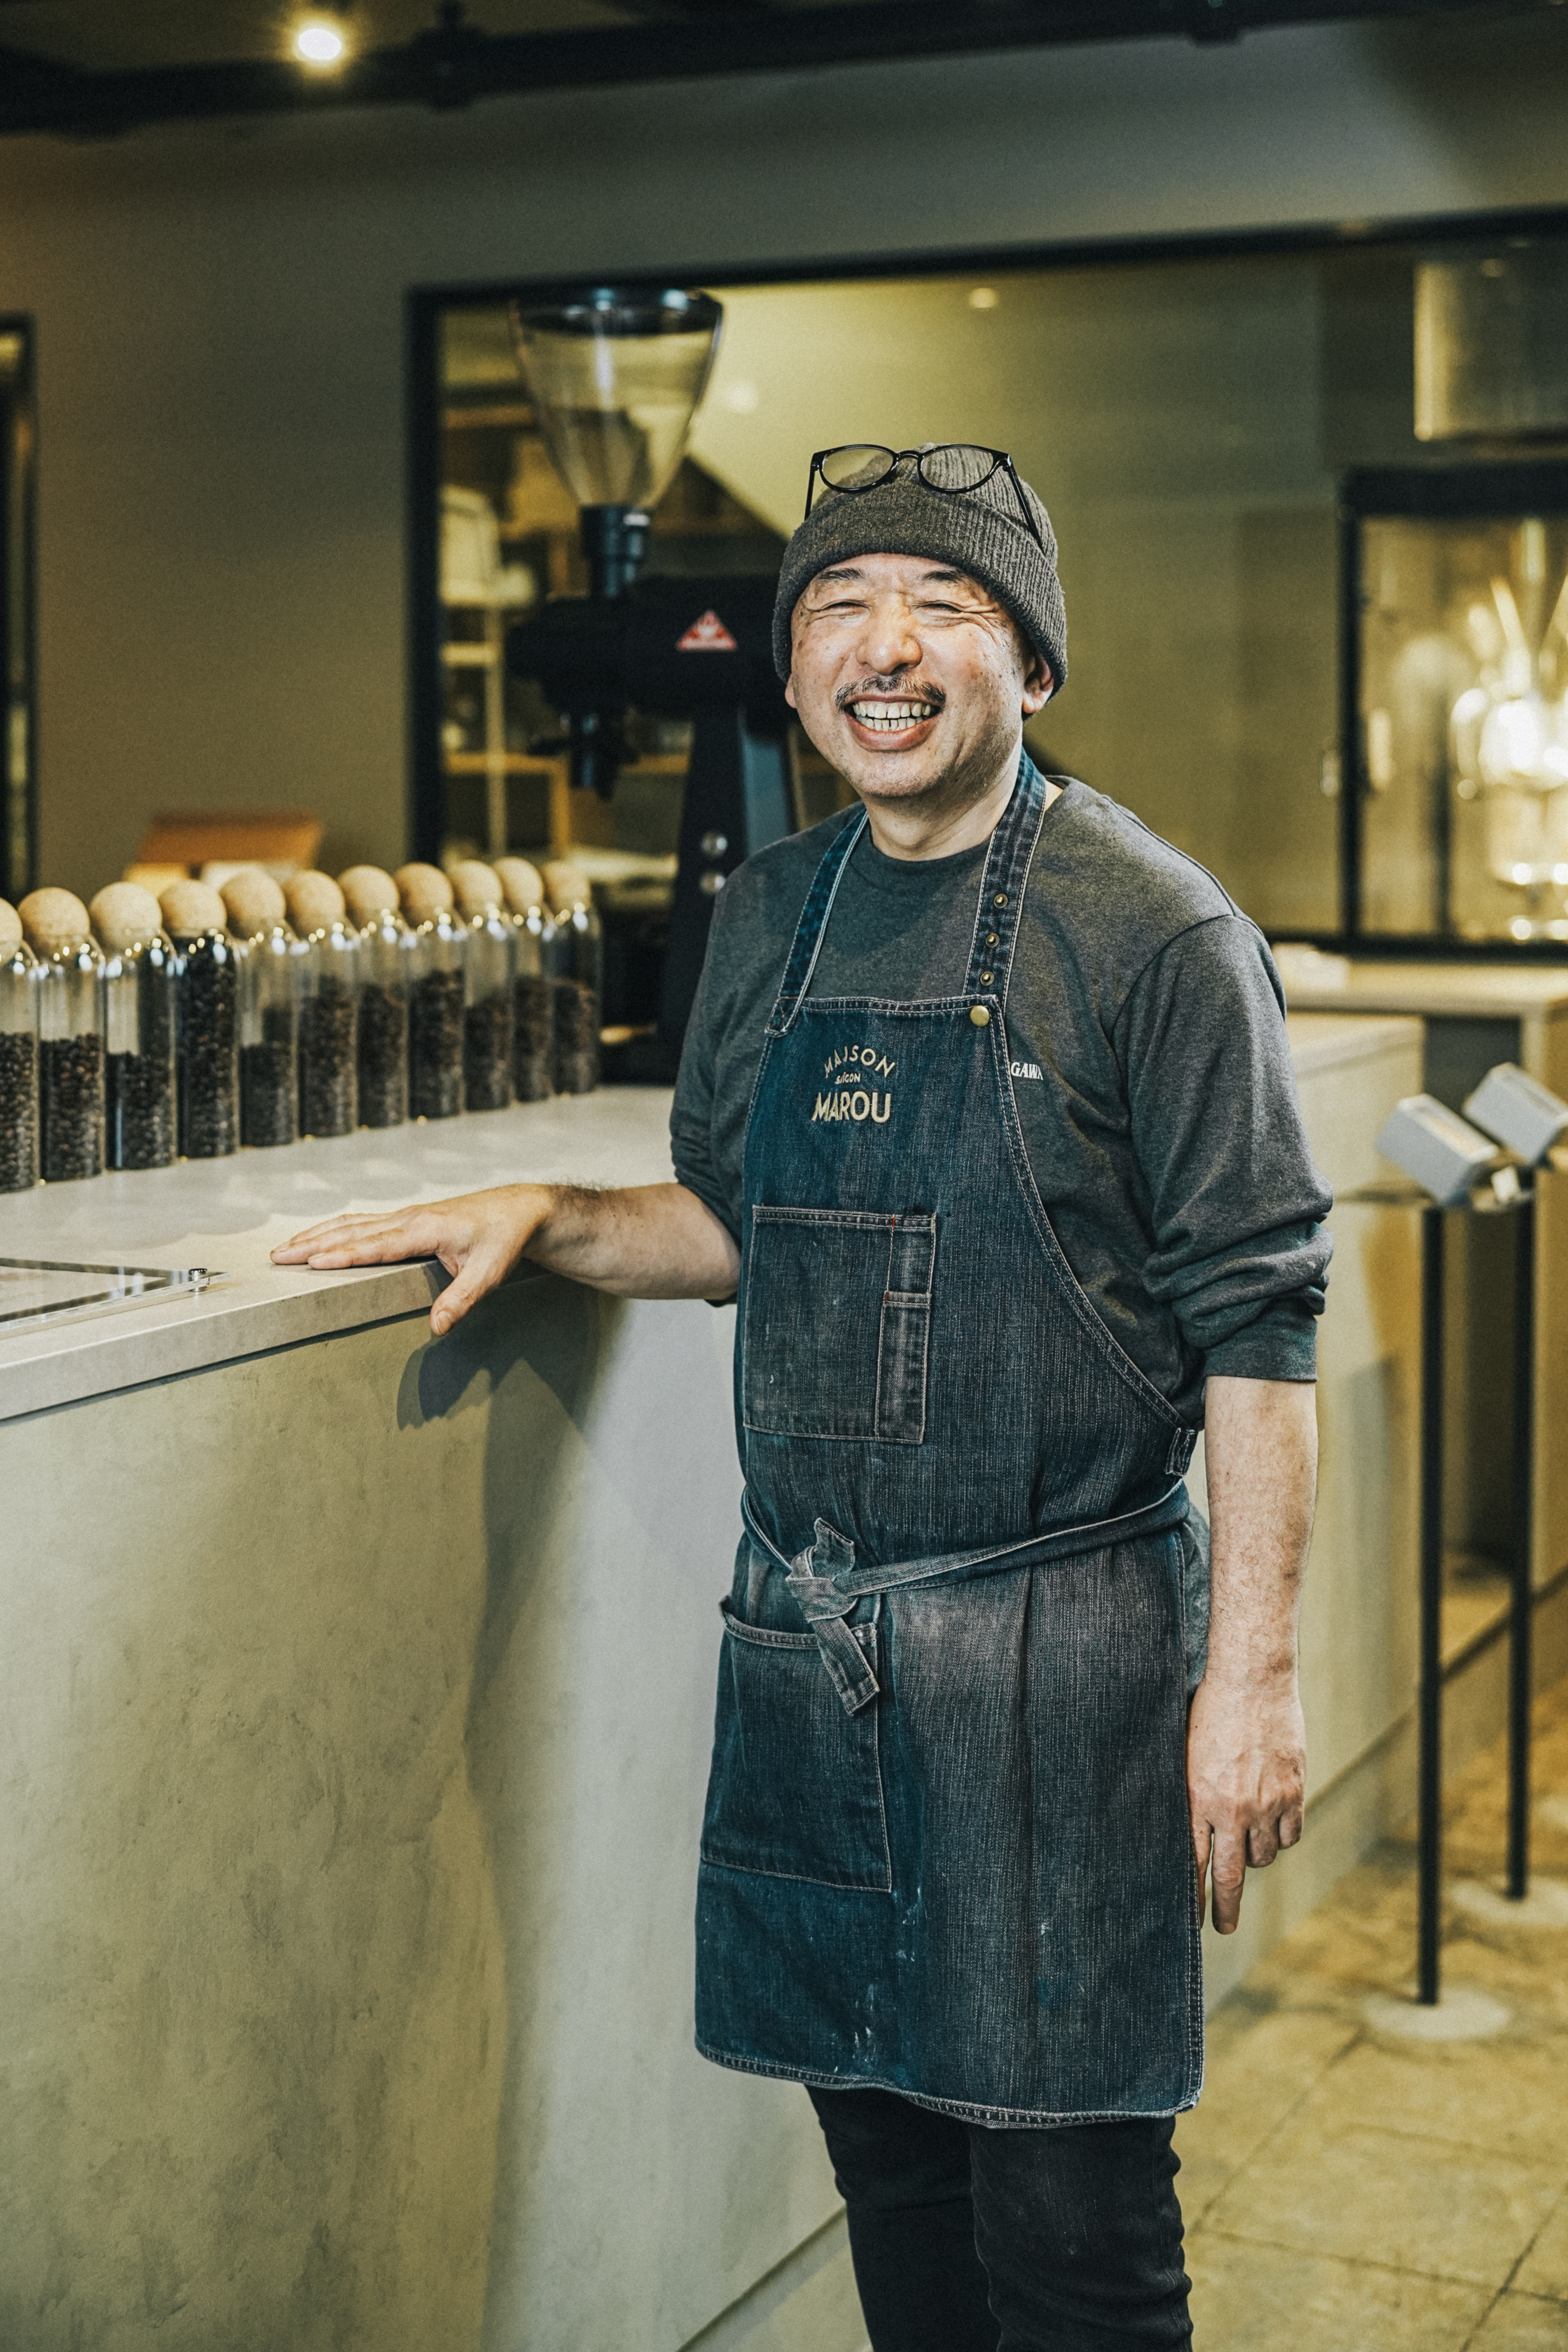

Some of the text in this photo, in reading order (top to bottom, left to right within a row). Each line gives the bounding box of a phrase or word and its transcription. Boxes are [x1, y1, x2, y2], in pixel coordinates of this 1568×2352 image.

[825, 1045, 896, 1079] MAISON
[1009, 1062, 1043, 1081] GAWA
[811, 1091, 891, 1123] MAROU
